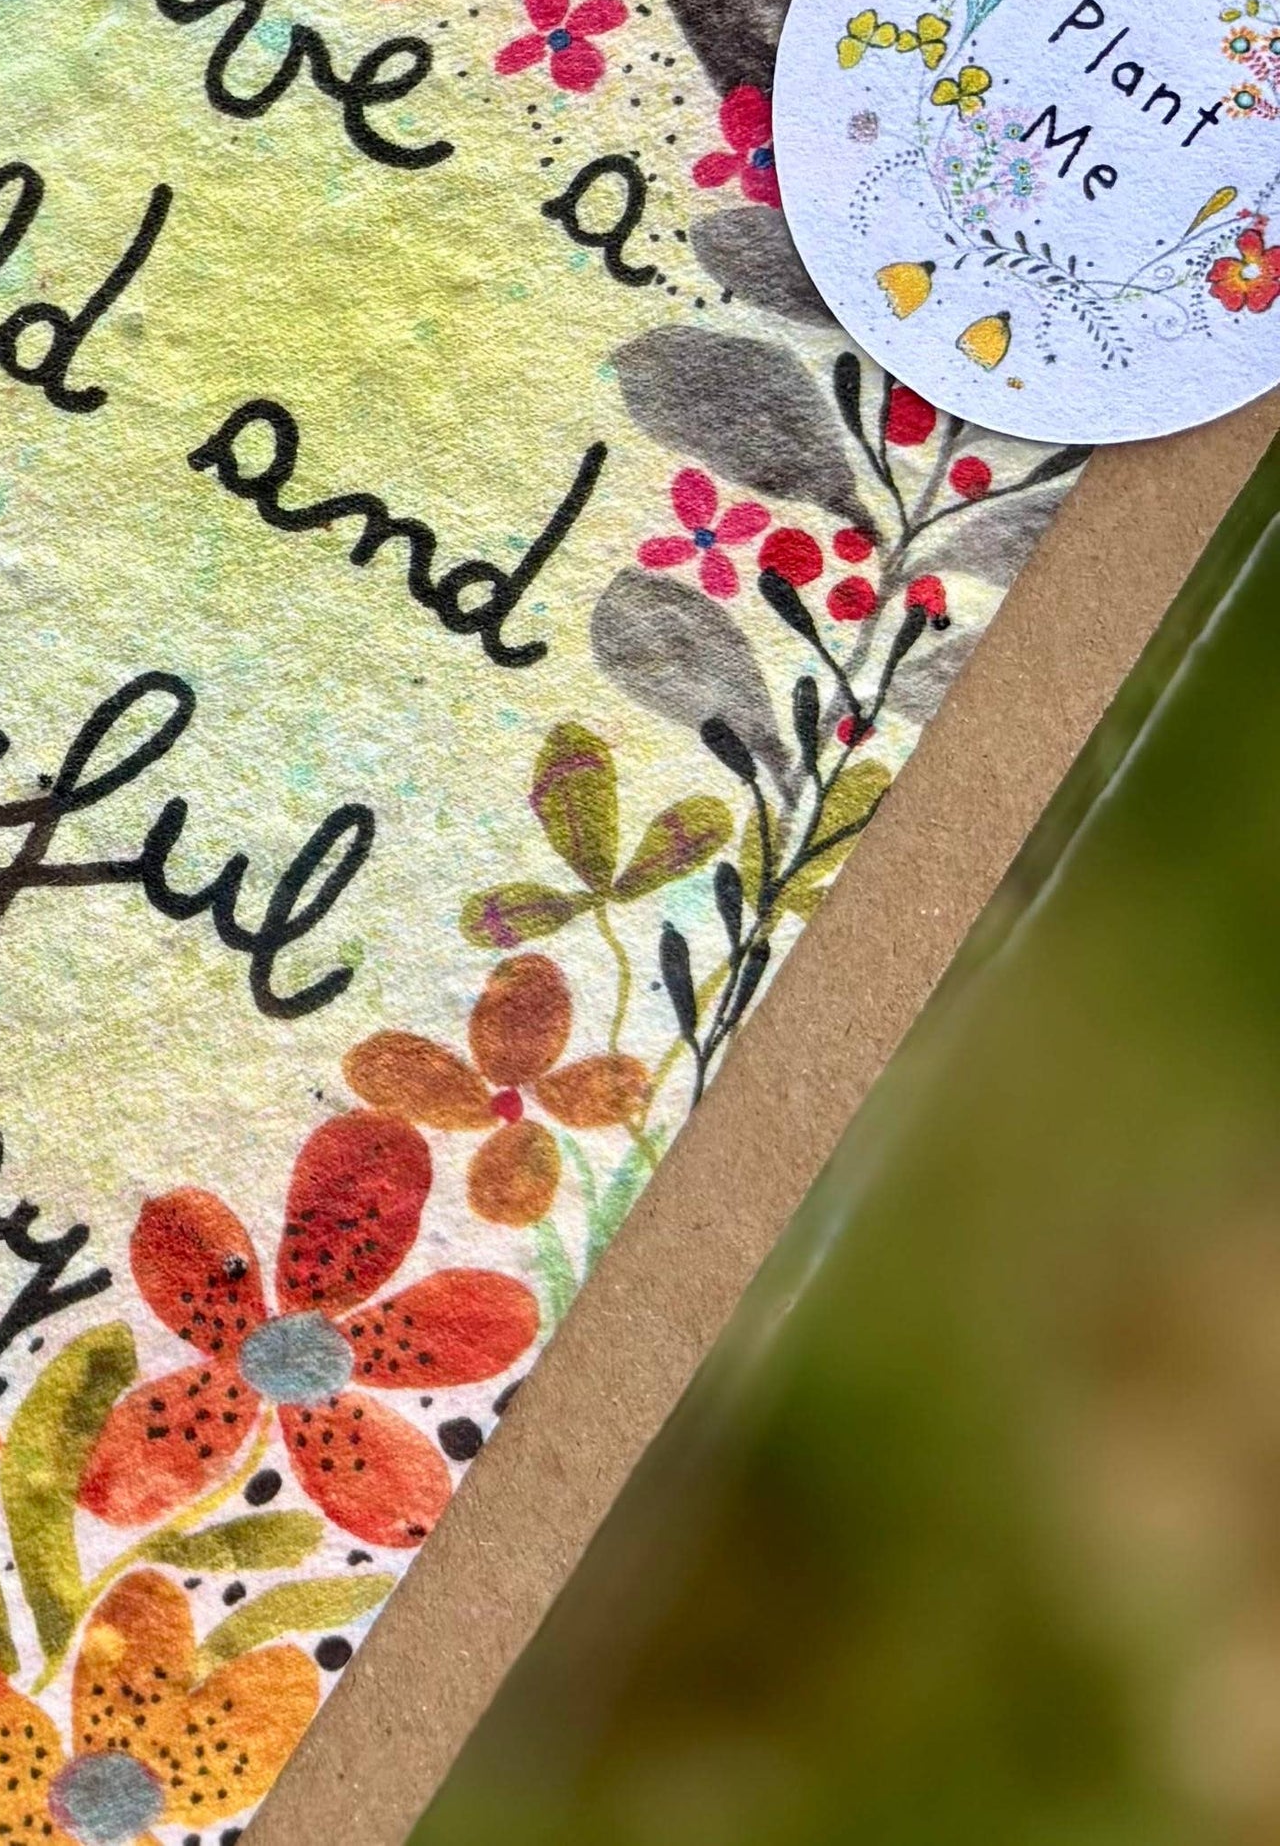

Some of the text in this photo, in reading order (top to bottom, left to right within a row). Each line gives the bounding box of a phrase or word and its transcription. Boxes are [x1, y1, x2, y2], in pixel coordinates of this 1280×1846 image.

[1018, 103, 1119, 201] Me
[540, 153, 659, 289] a
[186, 397, 609, 670] and
